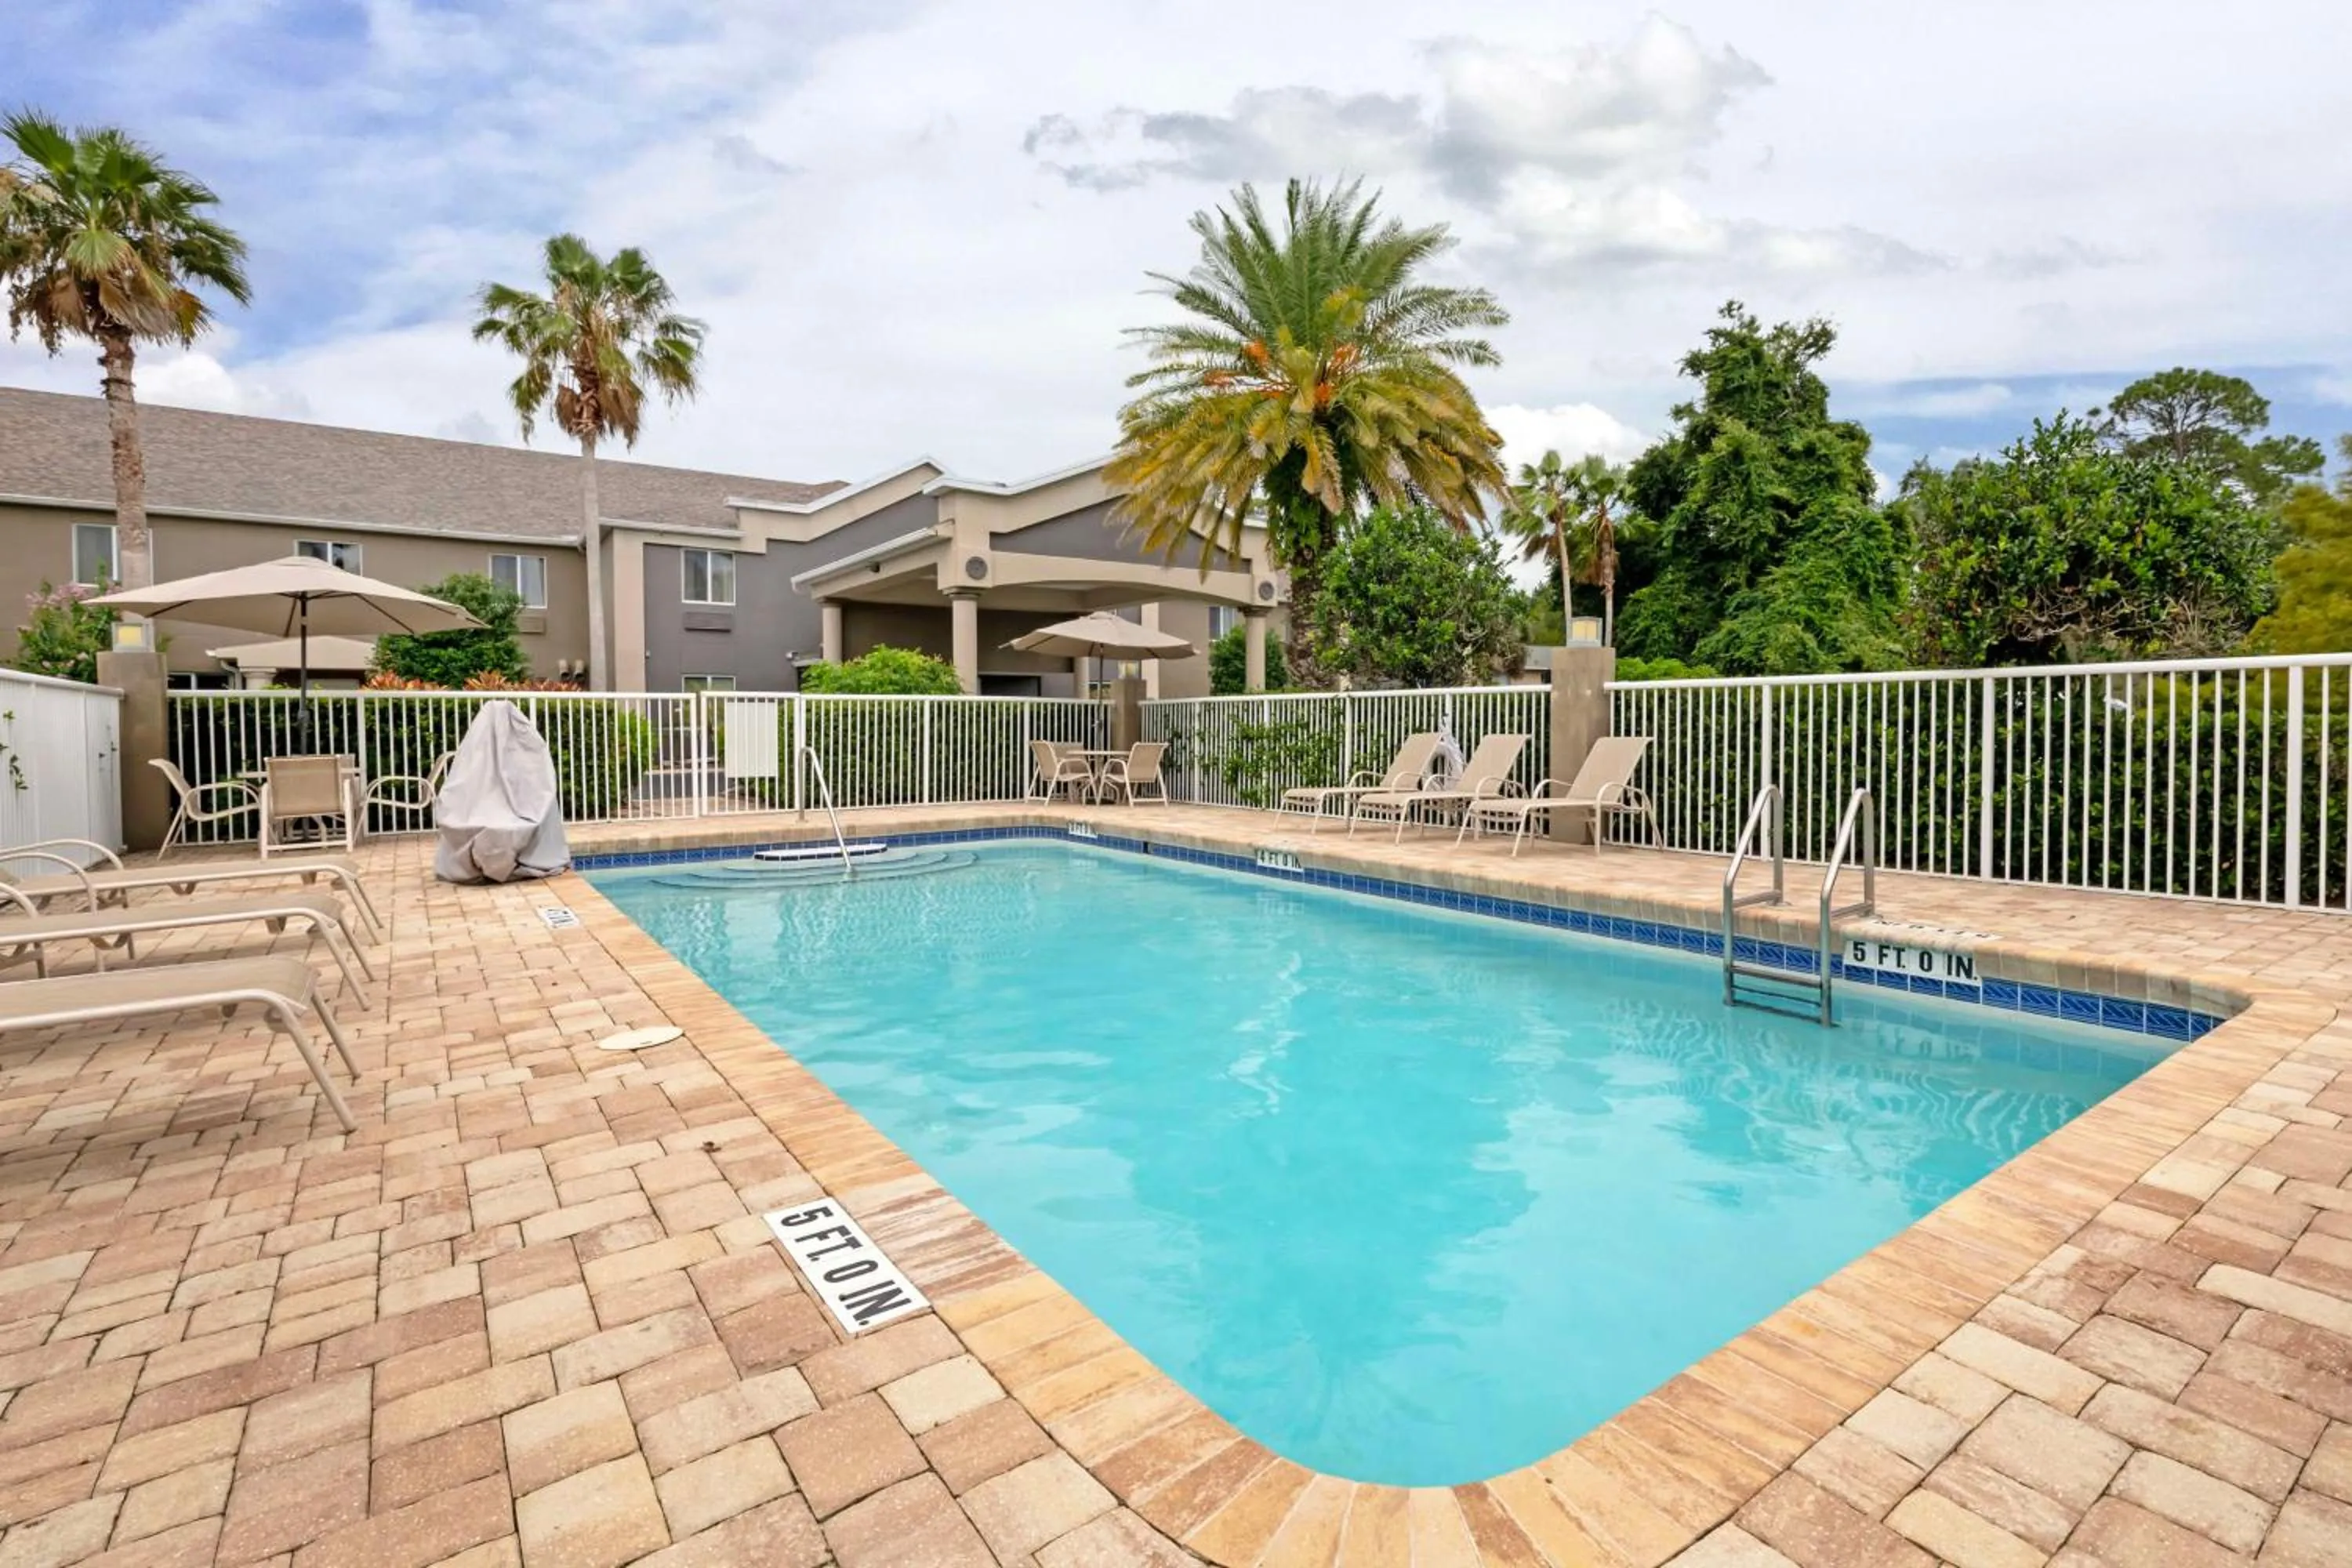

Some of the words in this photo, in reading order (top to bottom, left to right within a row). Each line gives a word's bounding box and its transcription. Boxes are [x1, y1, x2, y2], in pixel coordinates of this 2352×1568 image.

[1853, 942, 1867, 962] 5
[1878, 944, 1906, 968] FT.
[1947, 953, 1979, 980] IN.
[781, 1206, 834, 1227] 5
[794, 1225, 863, 1261] FT.
[838, 1279, 912, 1326] IN.
